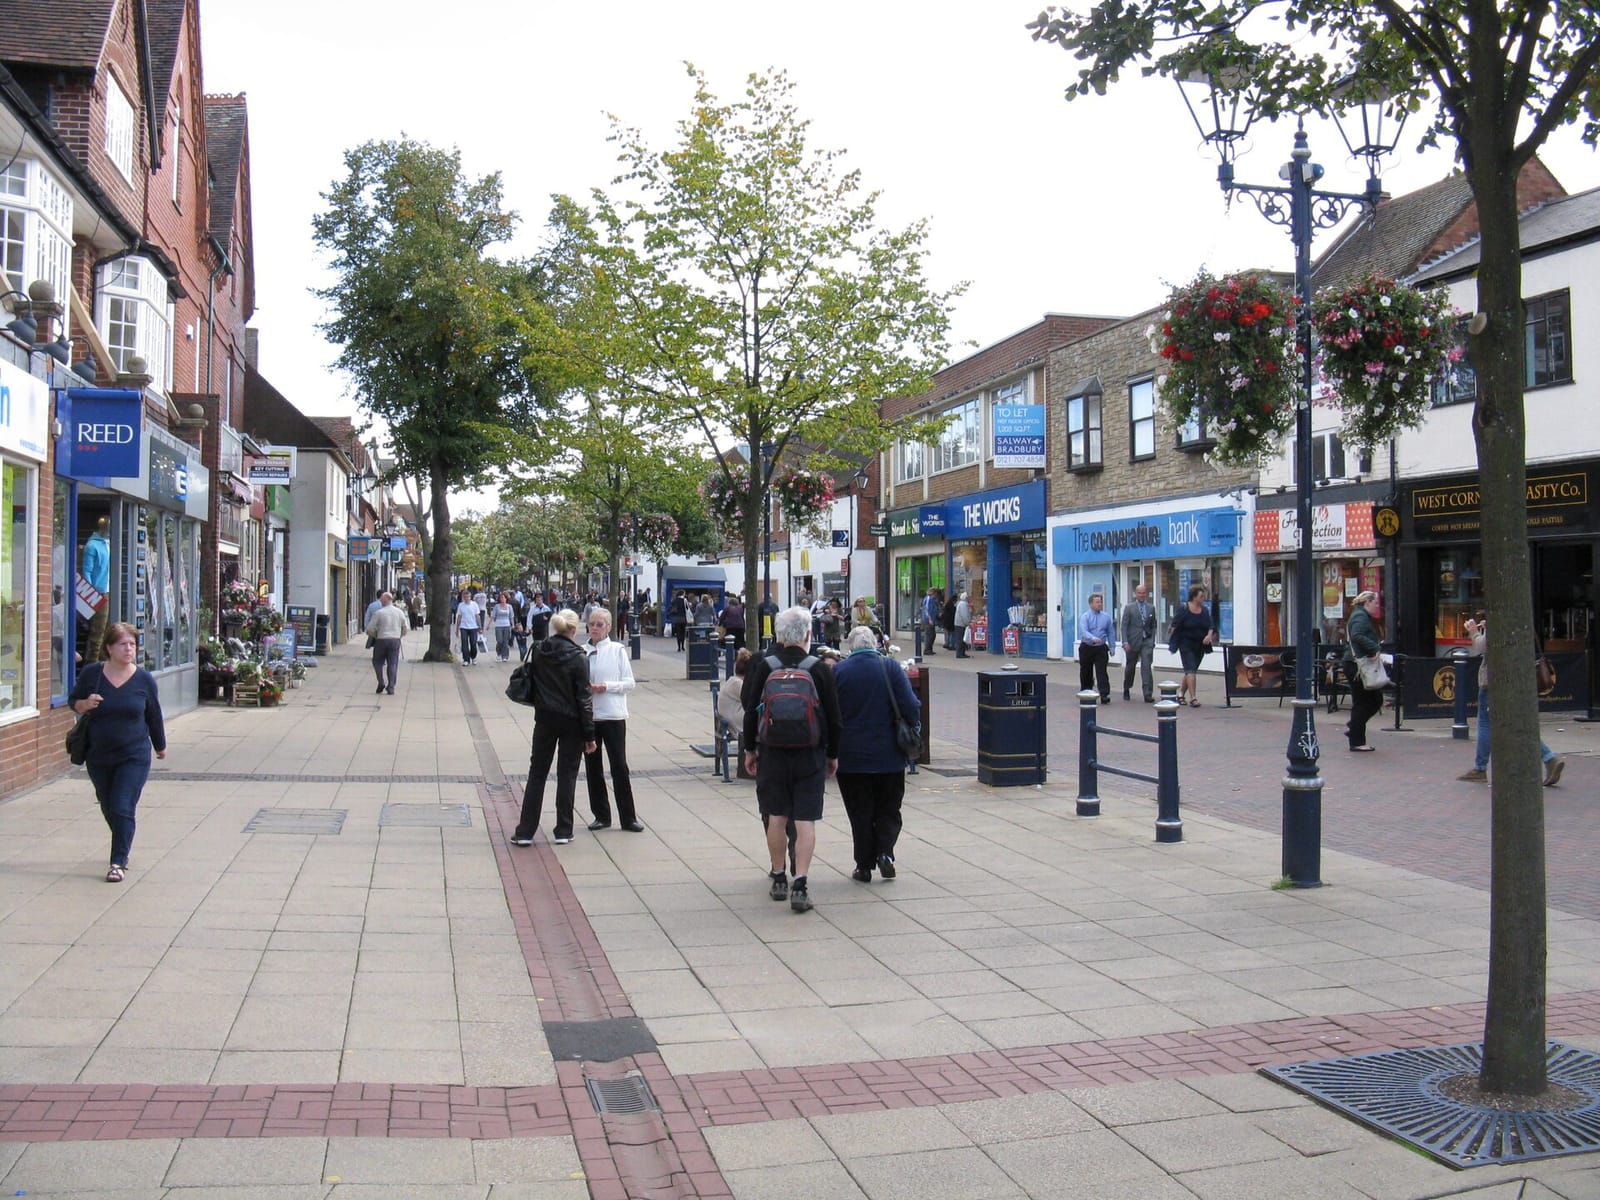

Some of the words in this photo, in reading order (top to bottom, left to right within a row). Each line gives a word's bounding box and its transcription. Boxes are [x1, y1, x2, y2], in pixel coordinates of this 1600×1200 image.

[997, 408, 1011, 417] TO
[1013, 408, 1028, 417] LET
[77, 422, 135, 444] REED
[997, 437, 1032, 445] SALWAY
[997, 445, 1042, 453] BRADBURY
[1418, 493, 1448, 509] WEST
[1449, 491, 1480, 507] CORN
[1526, 482, 1559, 500] ASTY
[963, 504, 980, 528] THE
[983, 496, 1020, 525] WORKS
[891, 520, 906, 537] Stead
[1072, 527, 1088, 553] The
[1168, 514, 1200, 545] bank
